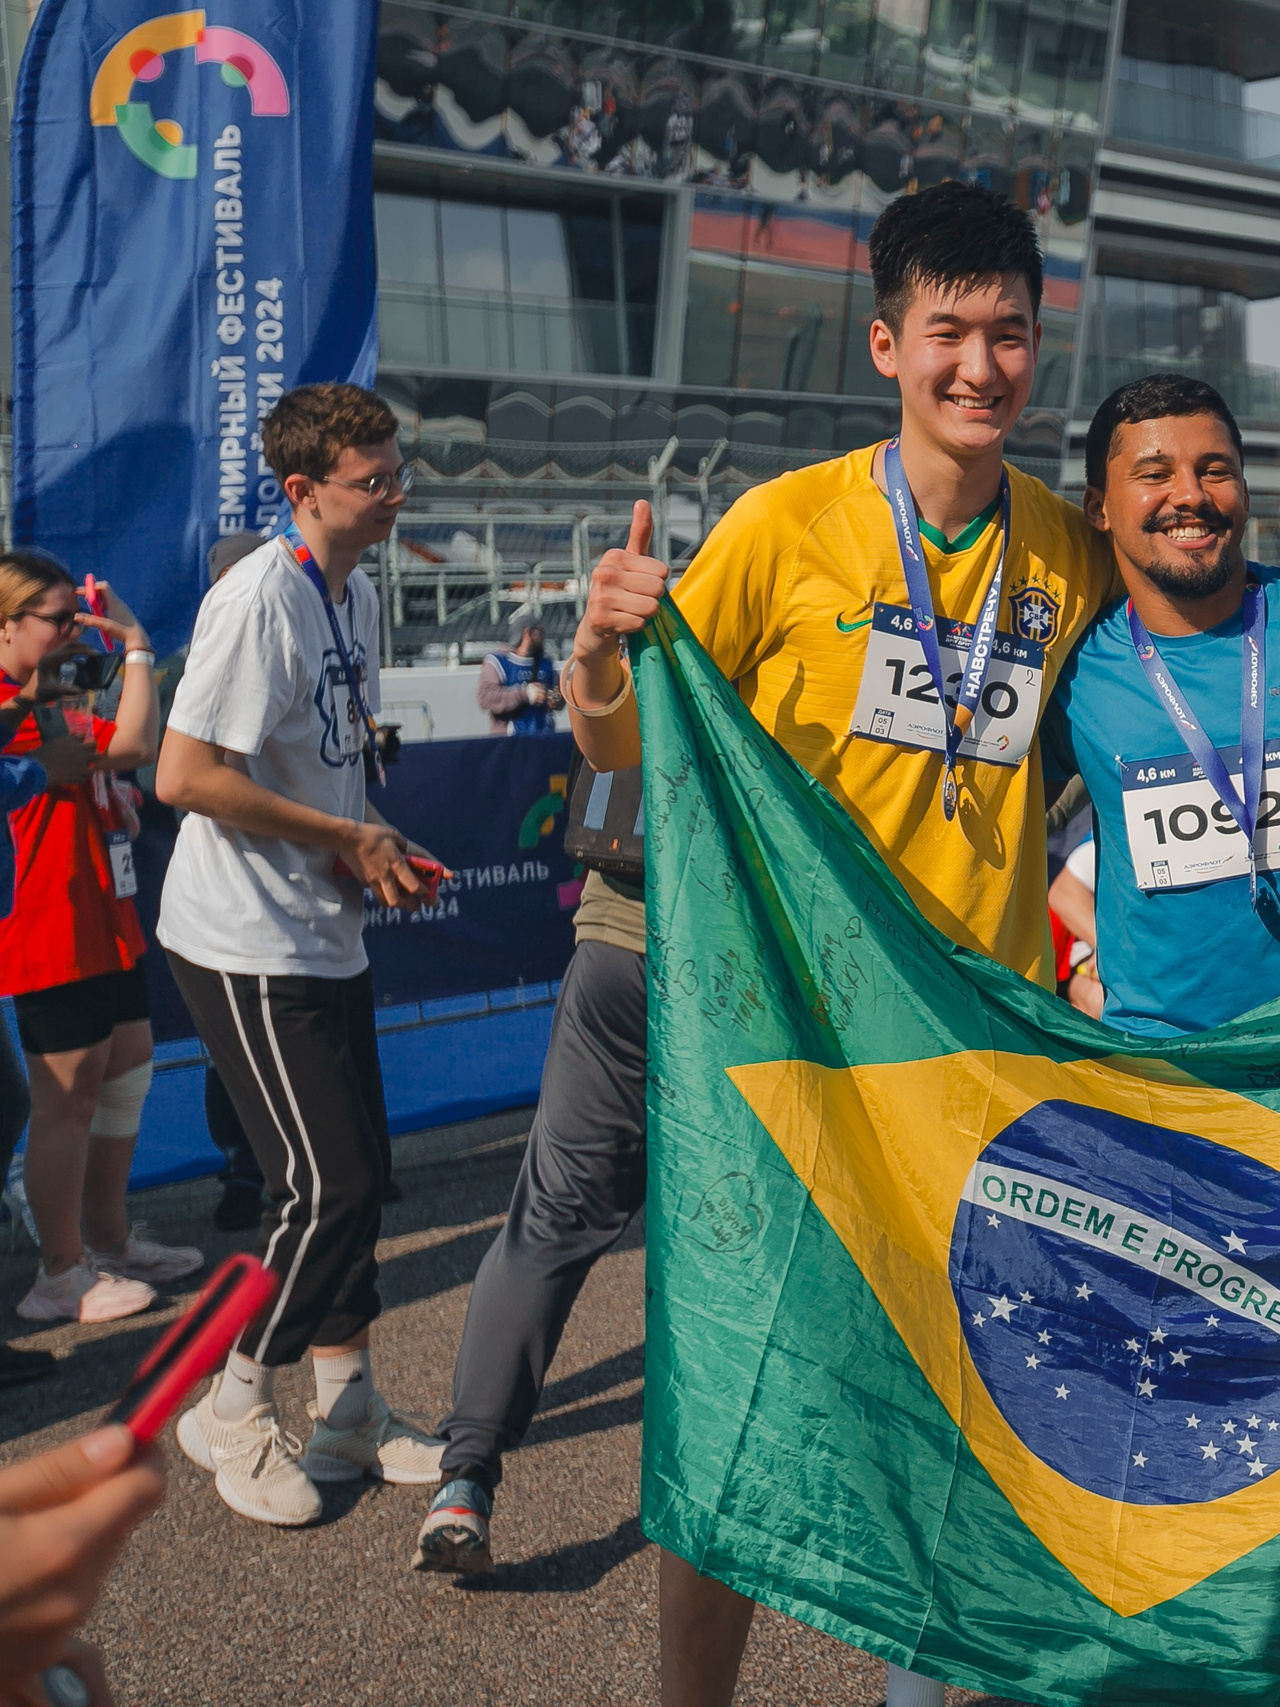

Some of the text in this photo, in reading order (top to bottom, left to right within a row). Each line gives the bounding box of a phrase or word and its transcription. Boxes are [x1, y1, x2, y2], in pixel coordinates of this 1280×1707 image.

[211, 124, 247, 537] ЕМИРНЫЙ ФЕСТИВАЛЬ
[255, 277, 284, 363] 2024
[895, 487, 914, 545] АЭРОФЛОТ
[890, 614, 914, 633] 4,6
[965, 587, 998, 698] НАВСТРЕЧУ
[1154, 672, 1187, 720] АЭРОФЛОТ
[1250, 649, 1260, 708] АЭРОФЛОТ
[1136, 767, 1158, 783] 4,6
[437, 860, 551, 894] СТИВАЛЬ
[981, 1174, 1116, 1240] ORDEM
[1122, 1223, 1149, 1254] E
